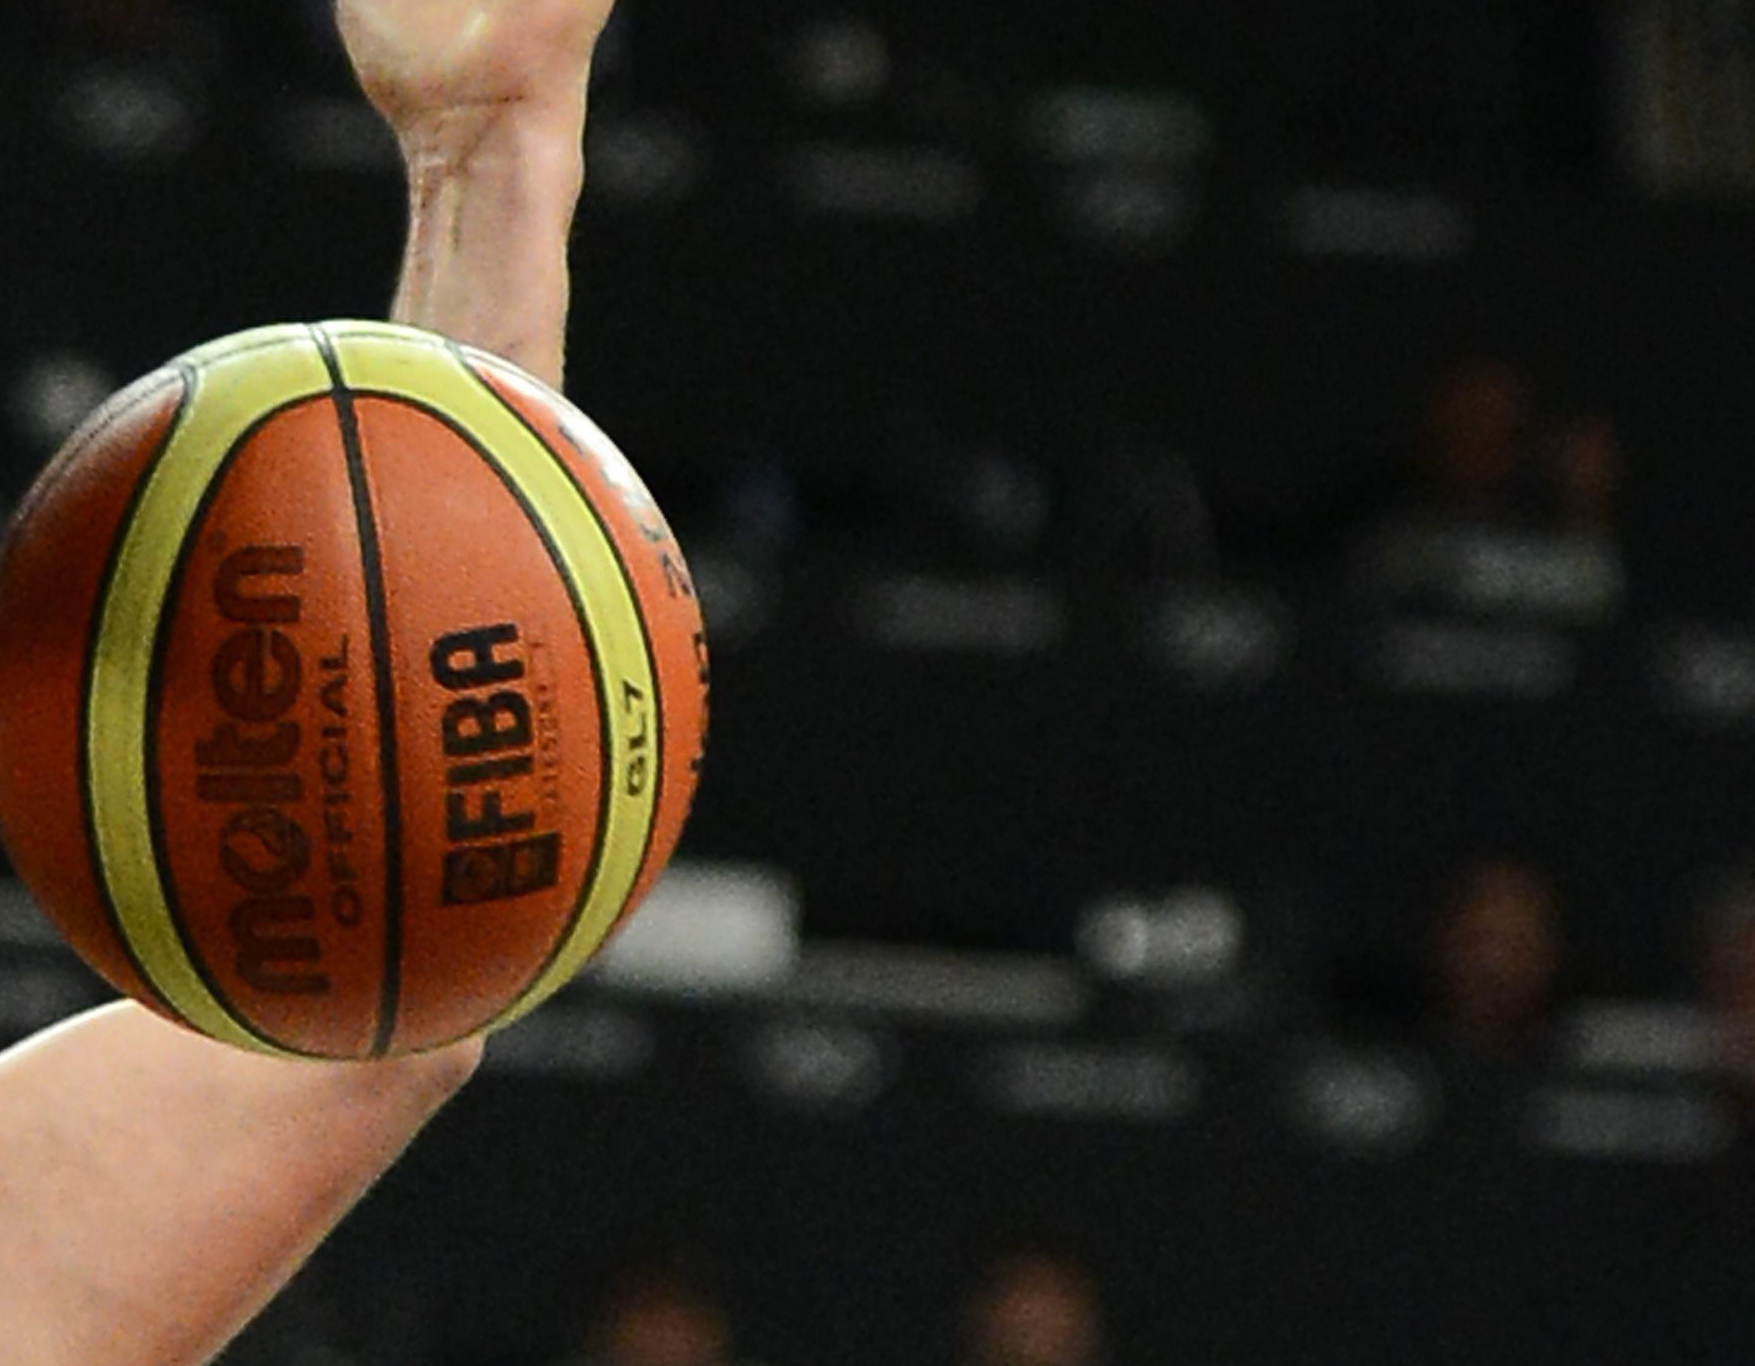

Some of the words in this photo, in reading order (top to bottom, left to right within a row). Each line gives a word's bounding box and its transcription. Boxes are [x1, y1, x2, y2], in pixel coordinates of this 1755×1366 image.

[195, 544, 329, 997] molten
[319, 634, 363, 927] OFFICIAL
[430, 623, 534, 842] FIBA
[622, 678, 649, 798] GL7
